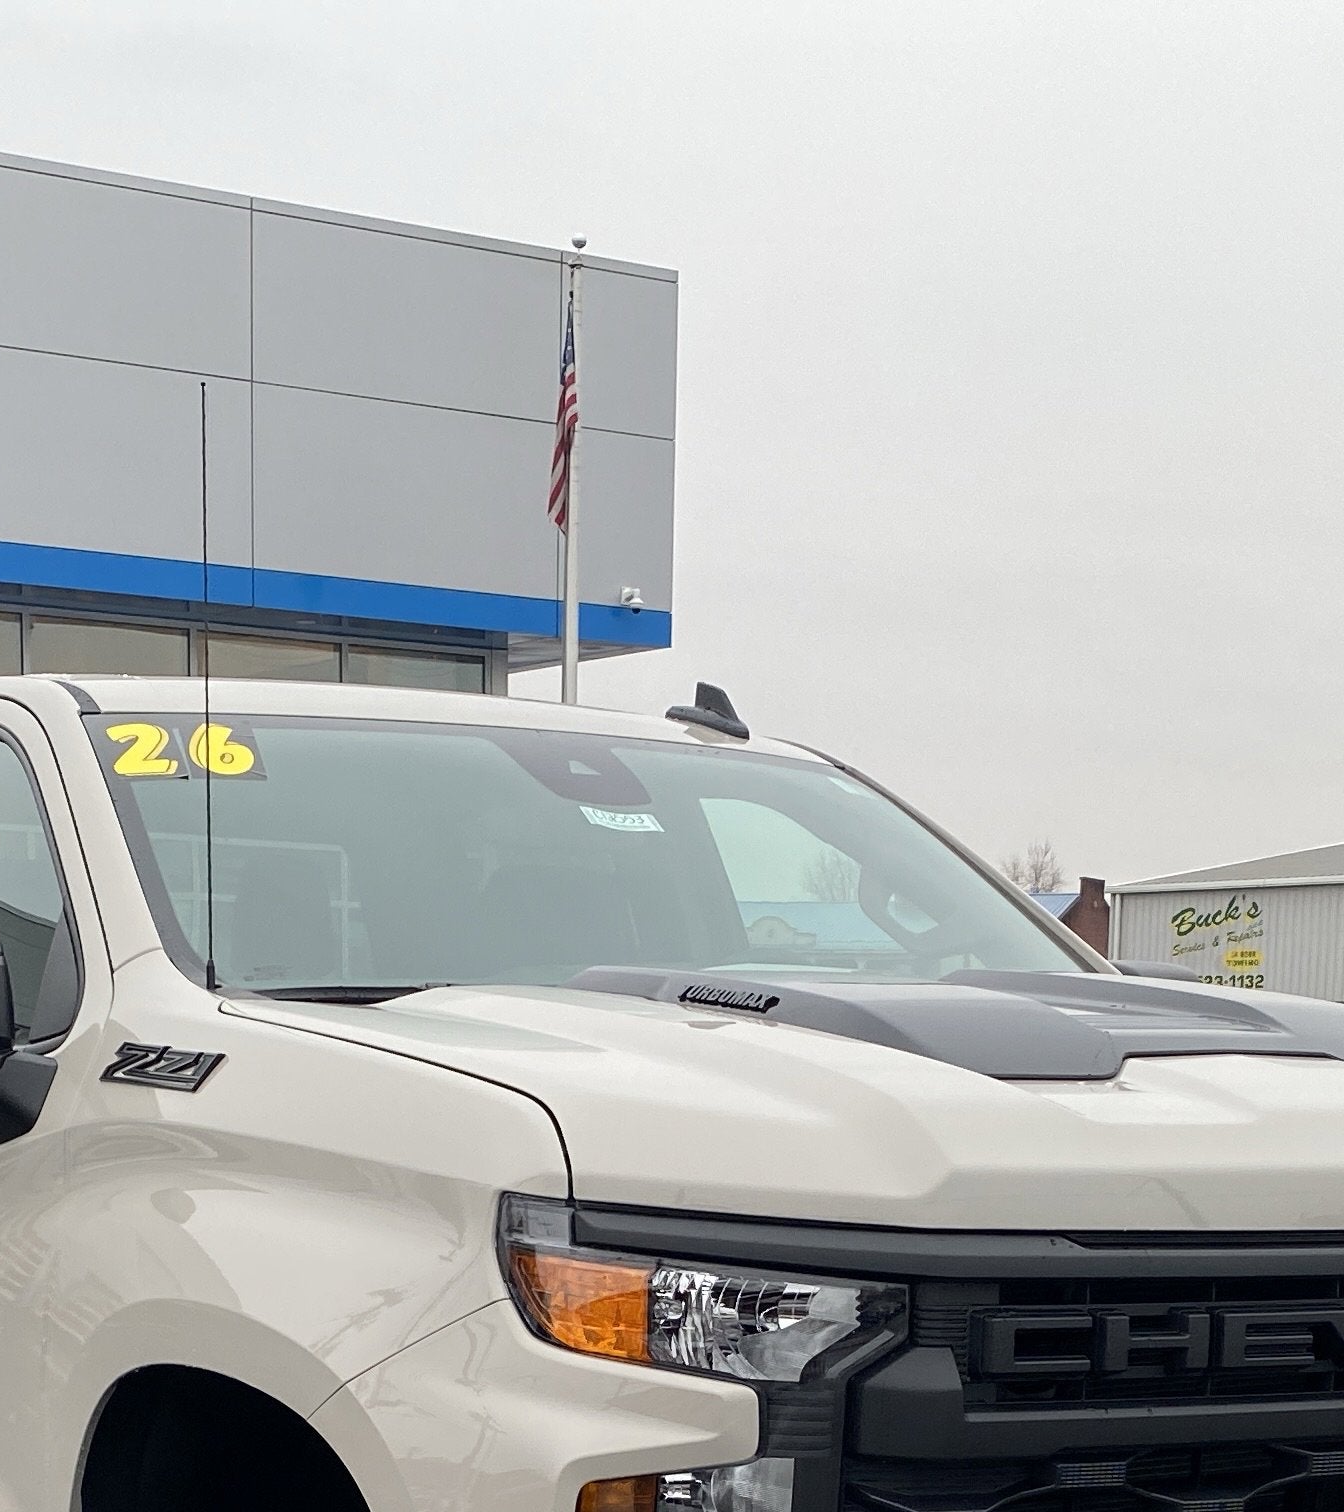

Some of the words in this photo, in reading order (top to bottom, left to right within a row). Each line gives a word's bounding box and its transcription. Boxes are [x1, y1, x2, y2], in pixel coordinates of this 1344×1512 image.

[106, 722, 255, 777] 26
[1171, 894, 1263, 936] Buck's
[99, 1042, 226, 1093] Z71
